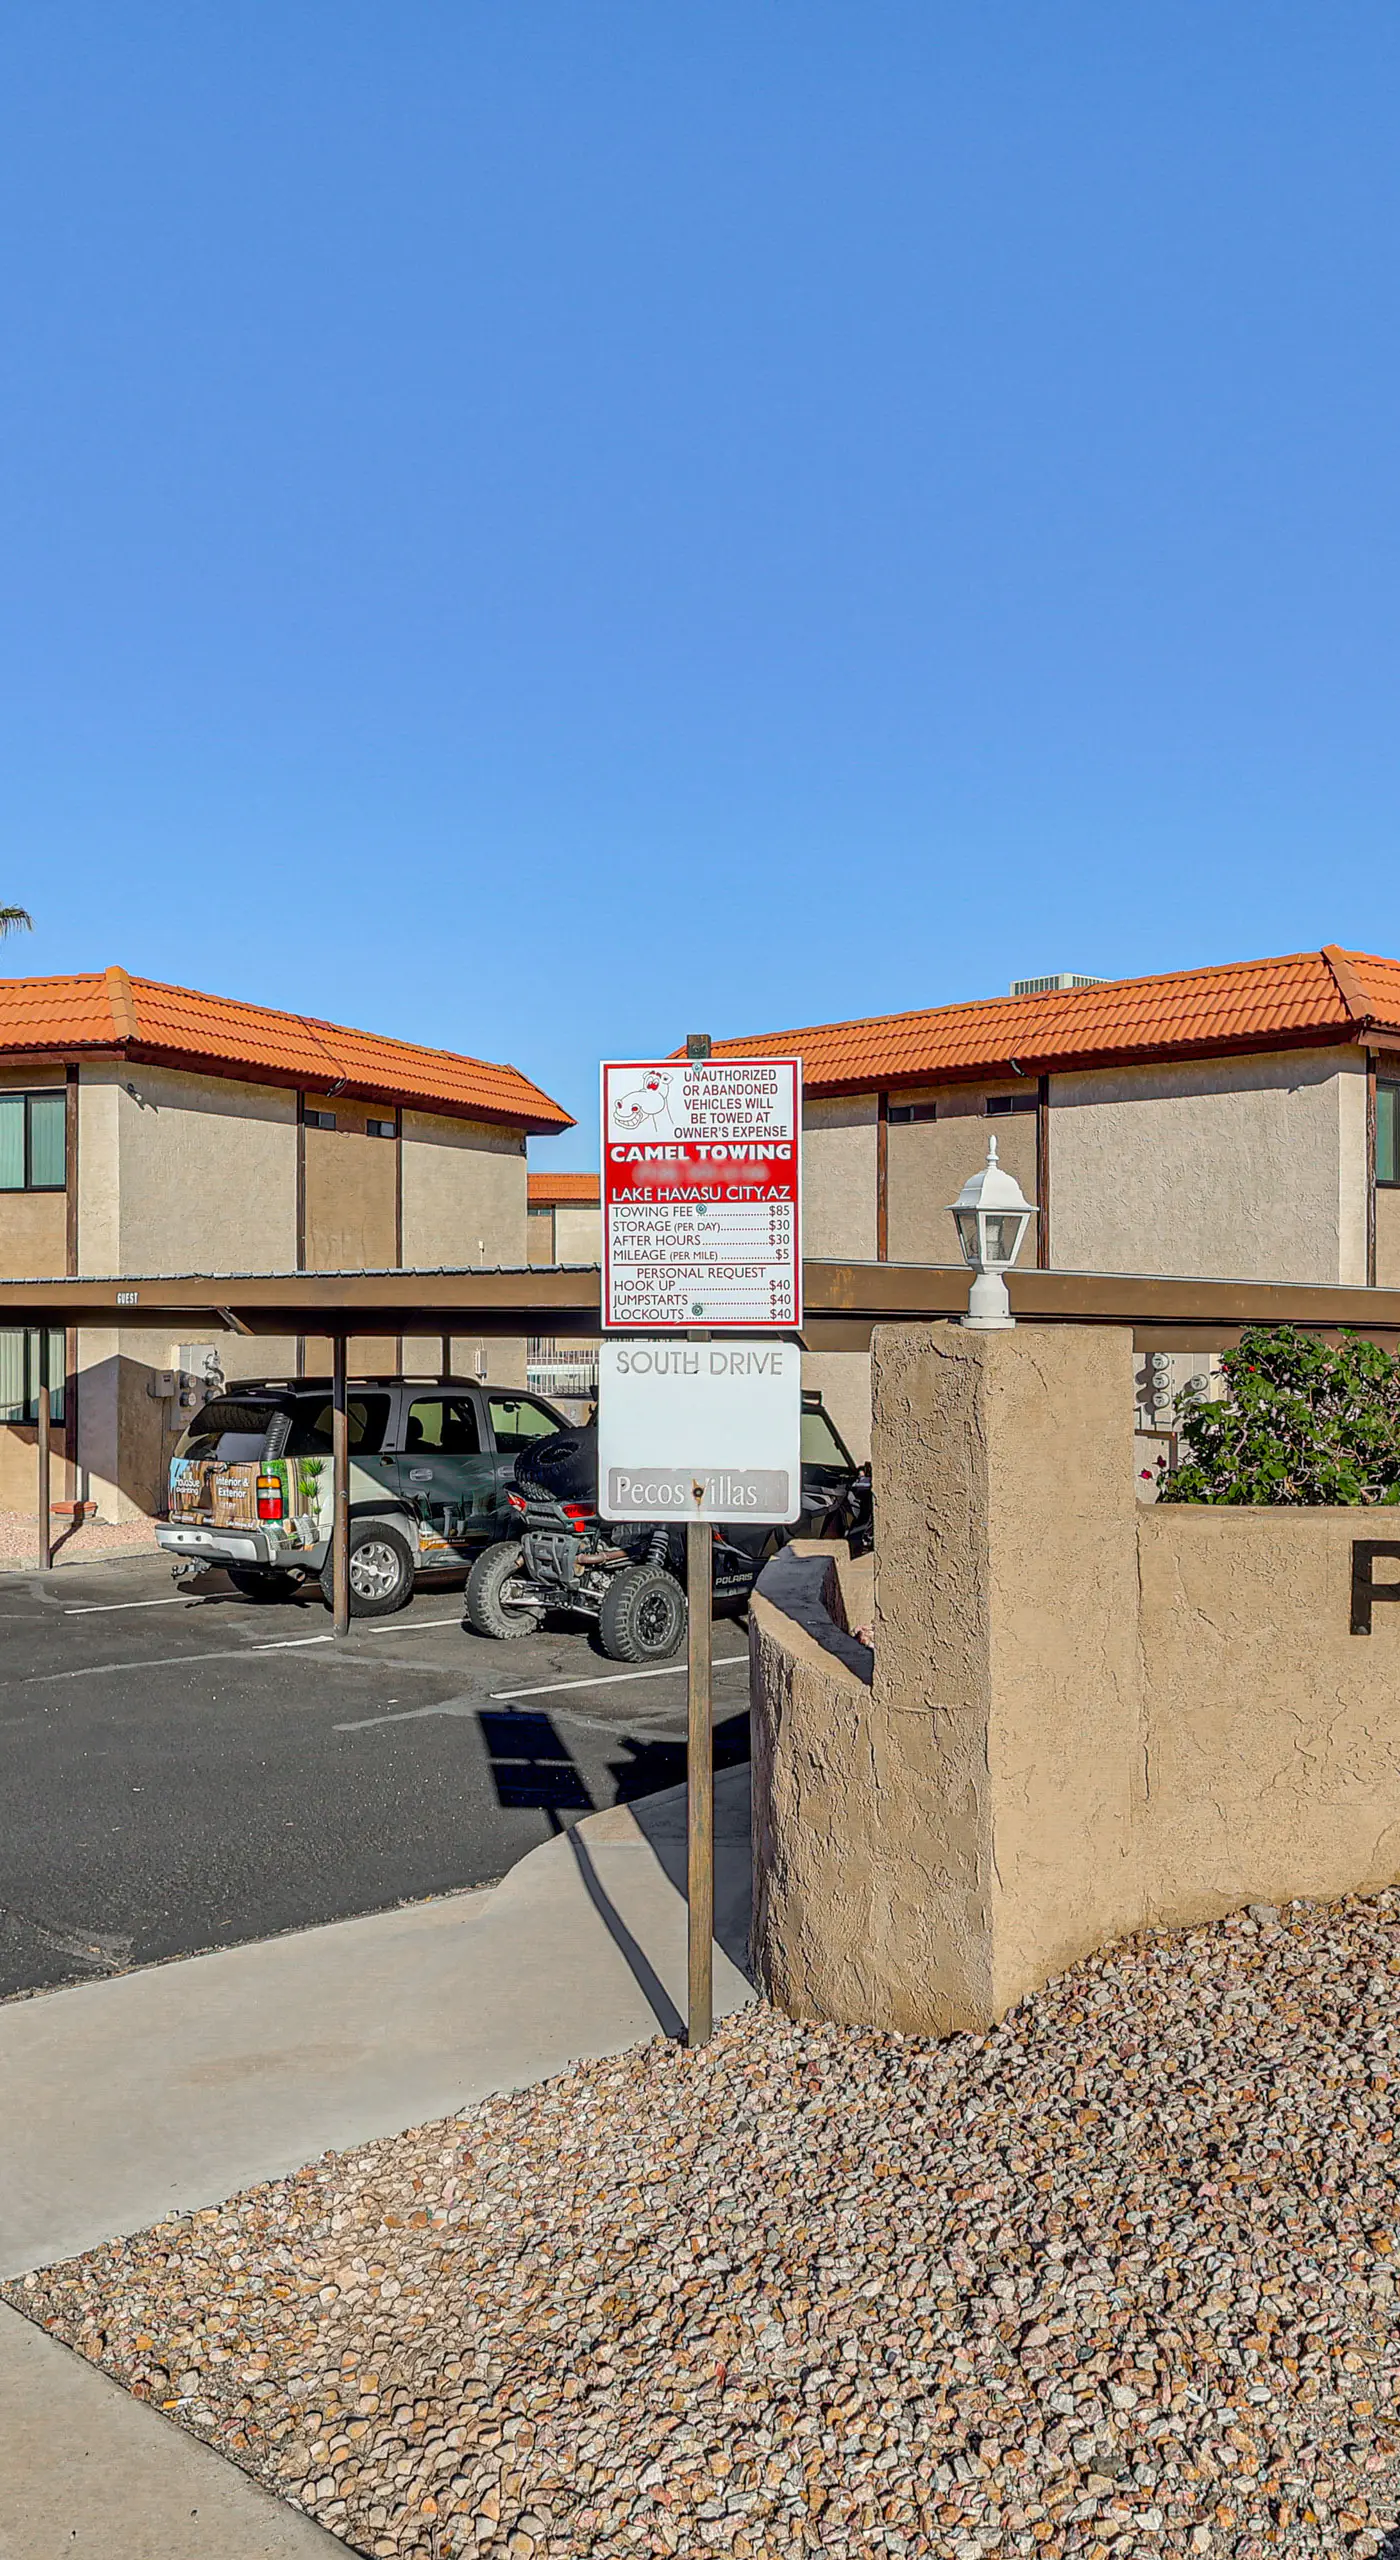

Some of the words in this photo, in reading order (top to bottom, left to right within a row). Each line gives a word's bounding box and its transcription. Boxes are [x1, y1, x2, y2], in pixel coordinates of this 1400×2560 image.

[684, 1069, 777, 1083] UNAUTHORIZED
[682, 1084, 700, 1096] OR
[703, 1083, 778, 1096] ABANDONED
[684, 1098, 742, 1111] VEHICLES
[745, 1097, 774, 1110] WILL
[690, 1112, 706, 1125] BE
[710, 1111, 753, 1124] TOWED
[755, 1111, 771, 1123] AT
[674, 1126, 729, 1139] OWNER'S
[732, 1125, 788, 1138] EXPENSE
[610, 1145, 690, 1162] CAMEL
[696, 1144, 791, 1160] TOWING
[612, 1187, 653, 1201] LAKE
[656, 1186, 721, 1201] HAVASU
[613, 1206, 669, 1218] TOWING
[673, 1206, 693, 1217] FEE
[768, 1204, 790, 1217] $85
[613, 1220, 671, 1232] STORAGE
[674, 1222, 695, 1233] (PER
[697, 1222, 721, 1233] DAY)
[768, 1219, 790, 1231] $30
[613, 1235, 652, 1246] AFTER
[655, 1234, 701, 1246] HOURS
[768, 1233, 790, 1246] $30
[613, 1249, 666, 1261] MILEAGE
[669, 1251, 690, 1262] (PER
[693, 1251, 718, 1262] MILE)
[775, 1248, 790, 1260] $5
[636, 1267, 704, 1279] PERSONAL
[708, 1266, 767, 1280] REQUEST
[613, 1280, 655, 1291] HOOK
[658, 1280, 676, 1291] UP
[769, 1279, 791, 1291] $40
[117, 1292, 138, 1305] GUEST
[613, 1294, 688, 1308] JUMPSTARTS
[769, 1293, 791, 1305] $40
[613, 1308, 684, 1320] LOCKOUTS
[769, 1307, 791, 1320] $40
[616, 1351, 699, 1375] SOUTH
[709, 1351, 783, 1375] DRIVE
[216, 1476, 242, 1487] Interior
[242, 1478, 250, 1487] &
[218, 1487, 247, 1498] Exterior
[616, 1476, 685, 1505] Pecos
[715, 1573, 753, 1585] POLARIS
